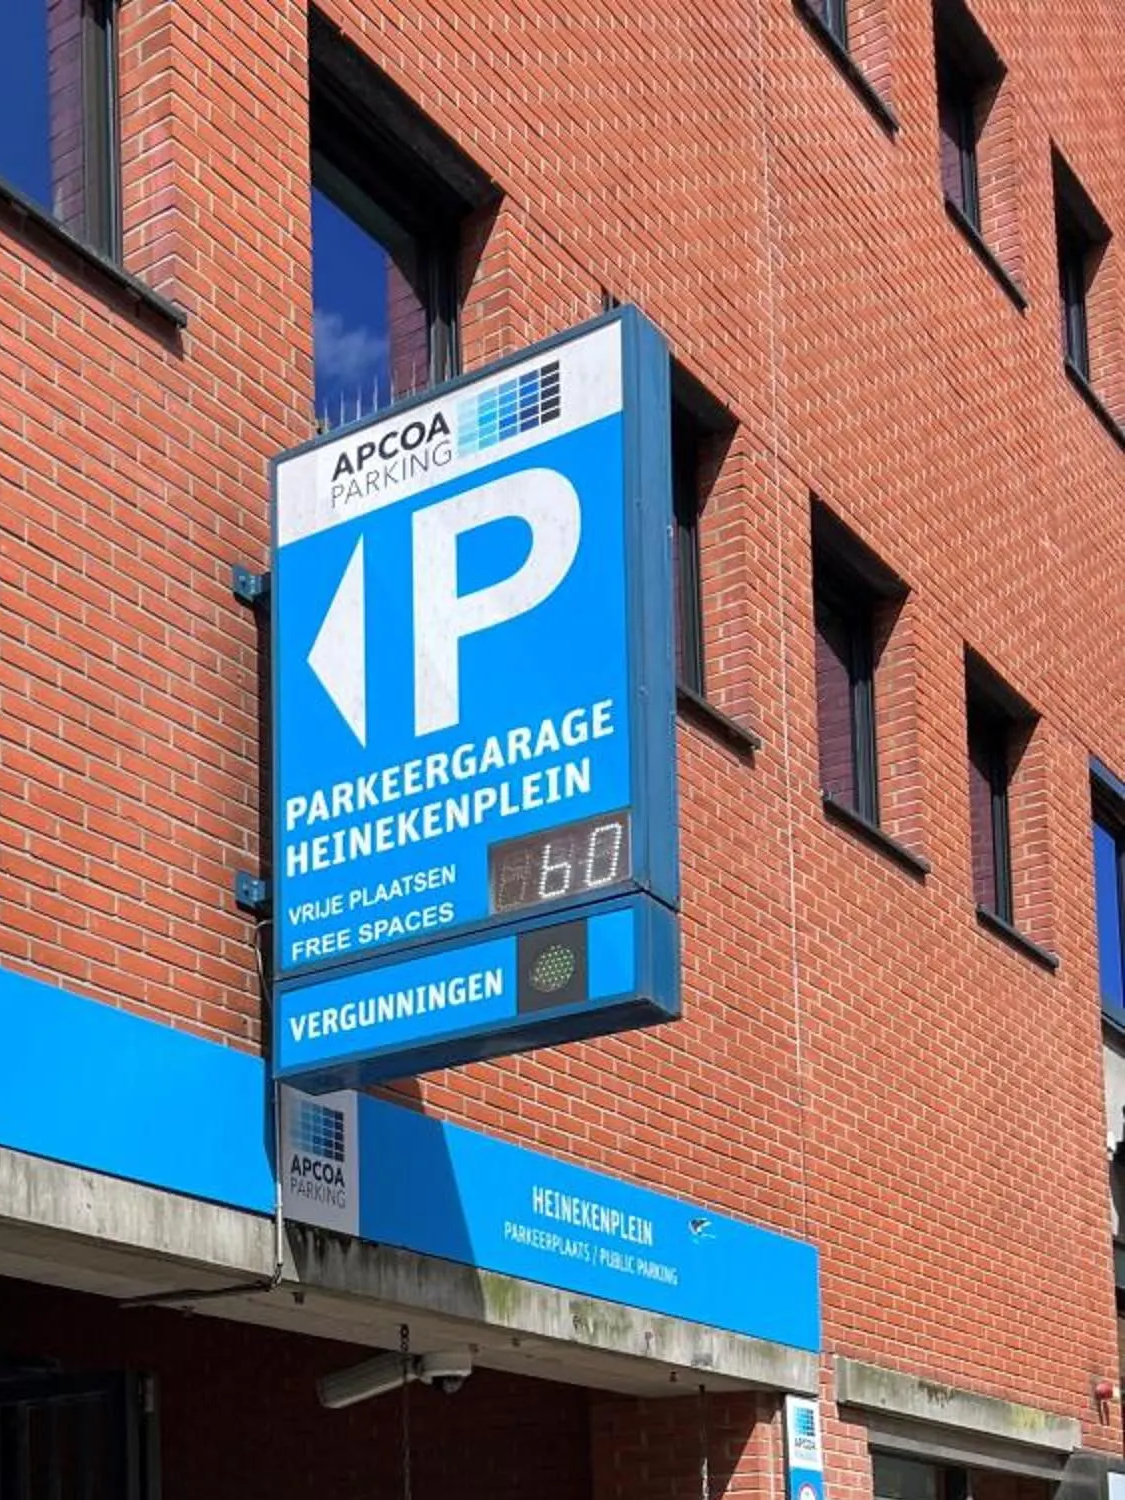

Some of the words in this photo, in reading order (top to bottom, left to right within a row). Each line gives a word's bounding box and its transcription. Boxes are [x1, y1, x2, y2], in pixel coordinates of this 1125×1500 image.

[330, 439, 453, 508] PARKING
[331, 412, 451, 481] APCOA
[412, 467, 582, 737] P
[286, 699, 615, 831] PARKEERGARAGE
[286, 757, 591, 877] HEINEKENPLEIN
[288, 894, 344, 926] VRIJE
[349, 864, 456, 911] PLAATSEN
[291, 922, 351, 961] FREE
[358, 901, 454, 943] SPACES
[290, 967, 504, 1042] VERGUNNINGEN
[290, 1155, 345, 1188] APCOA
[290, 1176, 346, 1209] PARKING
[531, 1185, 654, 1247] HEINEKENPLEIN
[503, 1221, 590, 1262] PARKEERPLAATS
[599, 1247, 635, 1276] PUBLIC
[637, 1257, 679, 1286] PARKING
